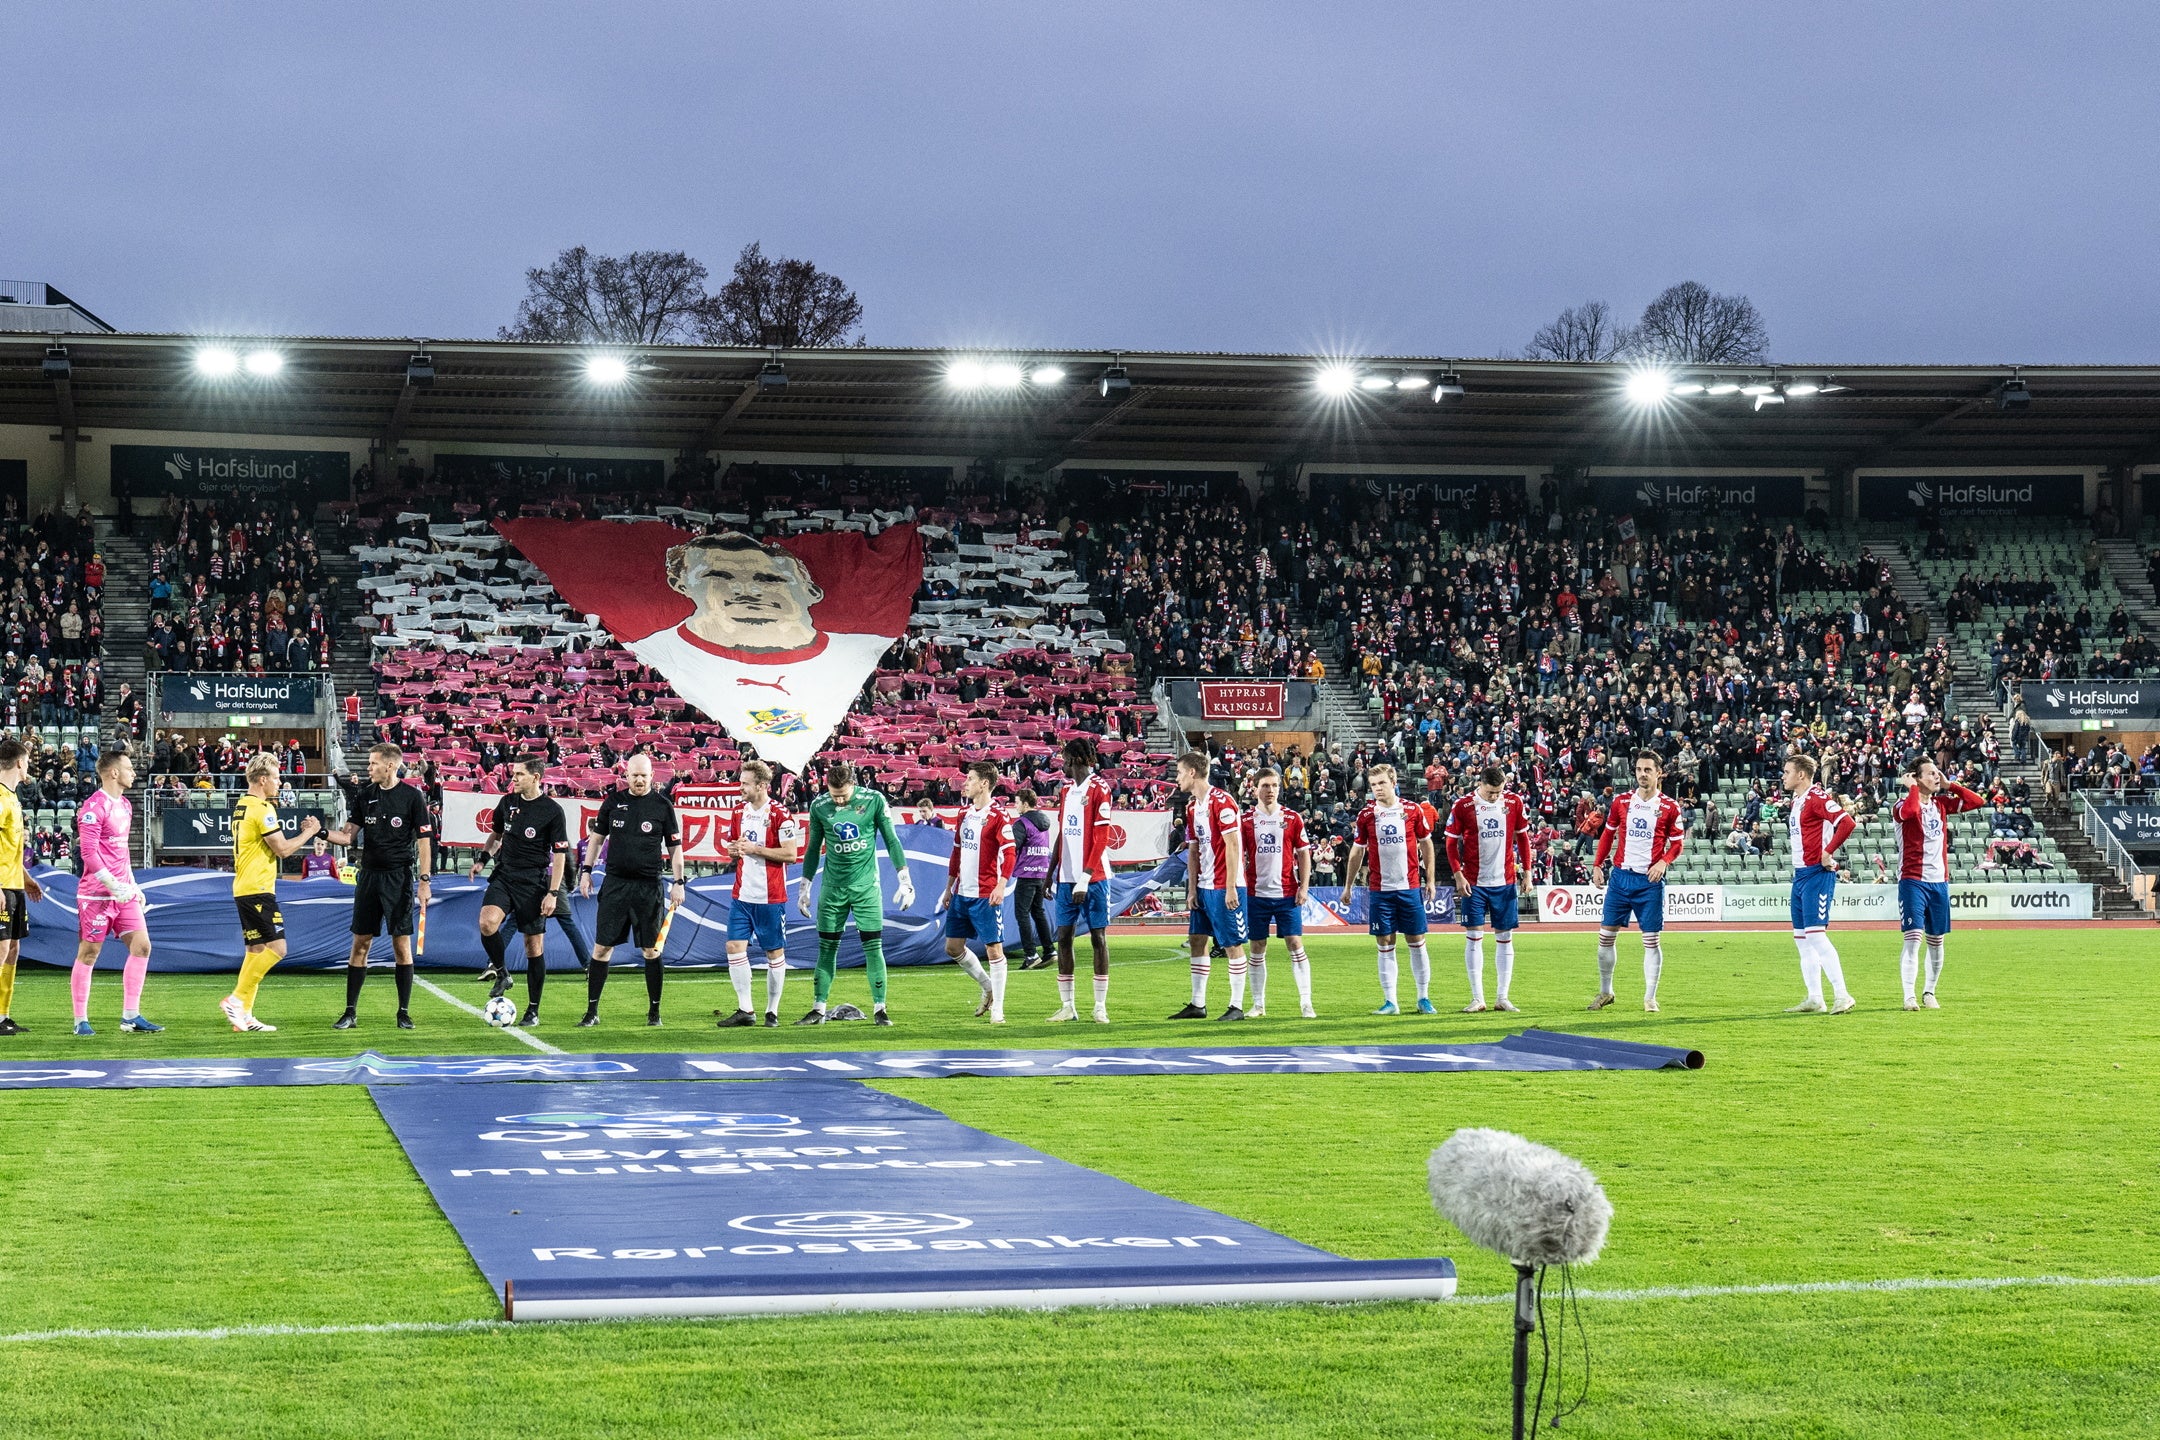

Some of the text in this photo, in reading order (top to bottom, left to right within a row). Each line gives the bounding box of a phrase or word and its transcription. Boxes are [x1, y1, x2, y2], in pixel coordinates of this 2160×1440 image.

[198, 457, 296, 479] Hafslund
[1939, 484, 2032, 503] Hafslund
[215, 683, 290, 699] Hafslund
[1219, 688, 1266, 698] HYPRAS
[2069, 690, 2139, 705] Hafslund
[215, 701, 278, 710] Gjør det fornybart
[1213, 702, 1274, 714] KRINGSJÅ
[2069, 707, 2084, 716] Gjør
[2097, 708, 2128, 716] fornybart
[1379, 836, 1404, 845] OBOS
[1481, 830, 1505, 839] OBOS
[1628, 829, 1653, 840] OBOS
[834, 840, 868, 854] OBOS
[1257, 846, 1282, 854] OBOS
[1575, 894, 1604, 905] RAG
[1668, 893, 1715, 905] RAGDE
[1725, 896, 1755, 909] Laget
[1759, 896, 1778, 907] ditt
[1842, 897, 1860, 907] Har
[1863, 896, 1885, 907] du?
[1950, 891, 1988, 908] attn
[2011, 891, 2071, 908] wattn
[1668, 905, 1715, 916] Eiendom
[1372, 922, 1380, 930] 24
[1907, 917, 1912, 925] 9
[685, 1053, 1493, 1073] LIGAEN
[478, 1125, 907, 1143] OBOS
[541, 1145, 909, 1161] Bygger
[531, 1234, 1243, 1261] RørosBanken
